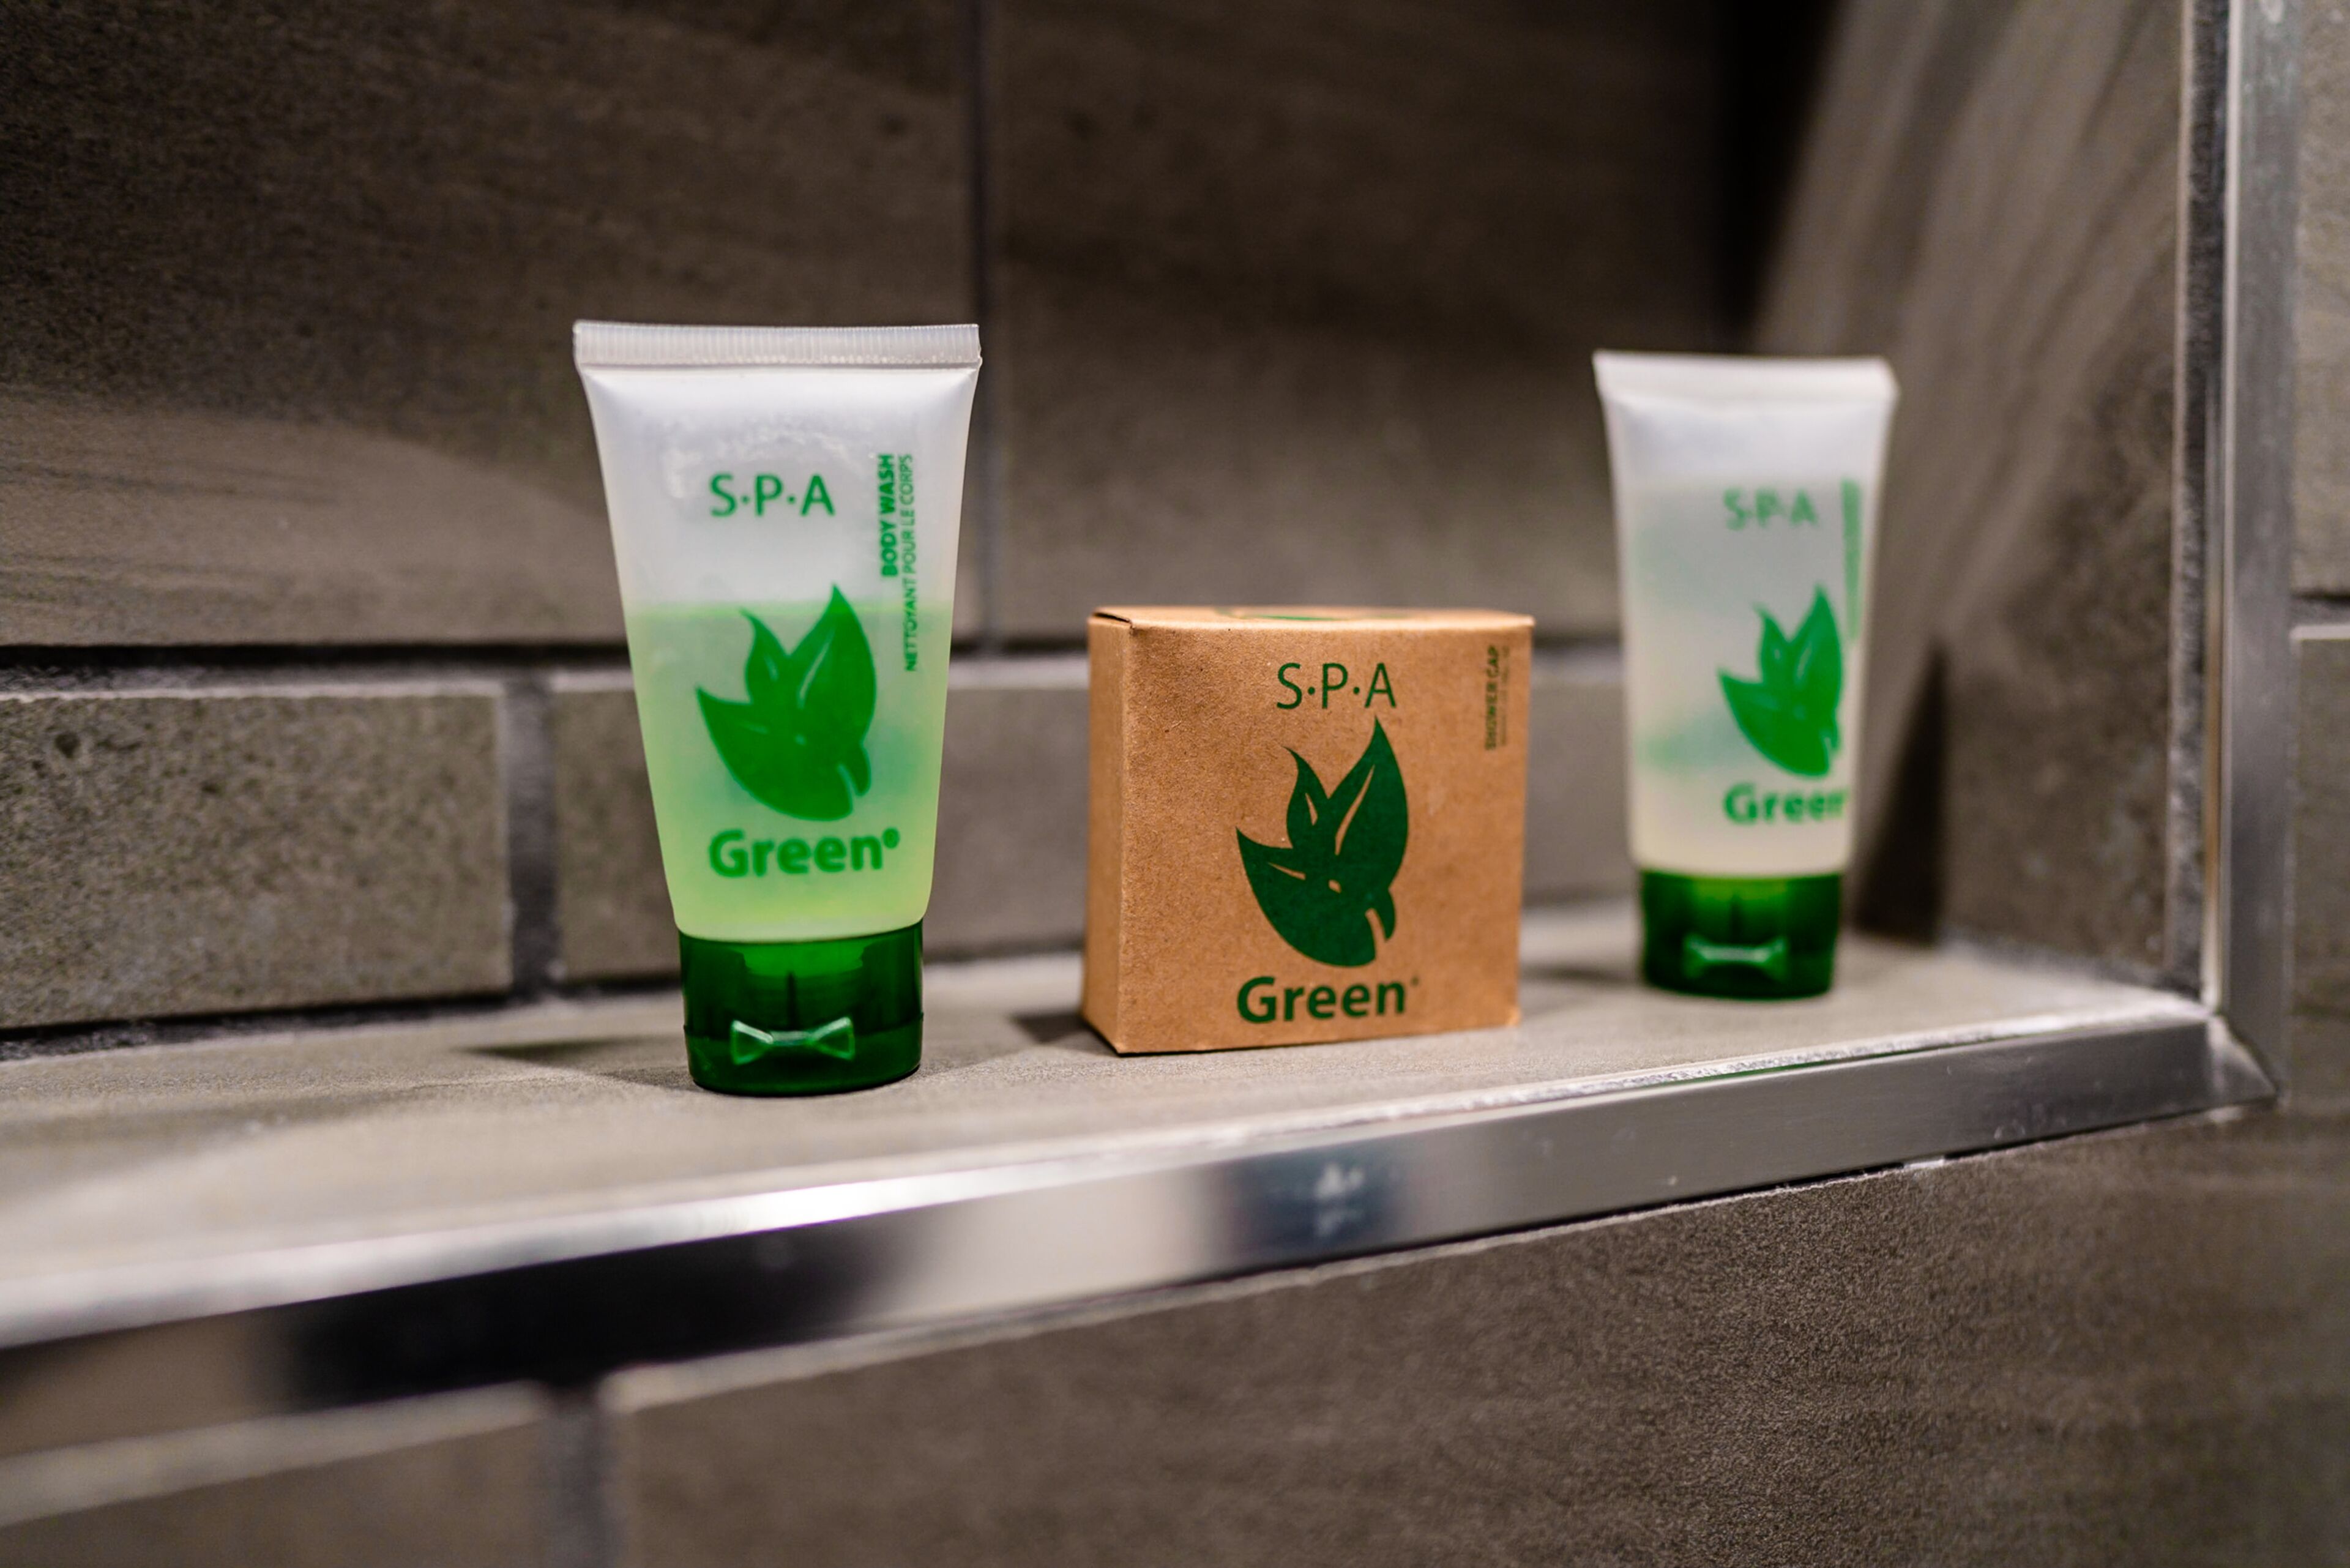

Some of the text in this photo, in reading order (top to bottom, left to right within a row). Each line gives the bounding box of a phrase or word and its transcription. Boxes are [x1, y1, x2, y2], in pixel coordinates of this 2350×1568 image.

[877, 454, 898, 577] BODY WASH
[898, 454, 917, 672] NETTOYANT POUR LE CORPS
